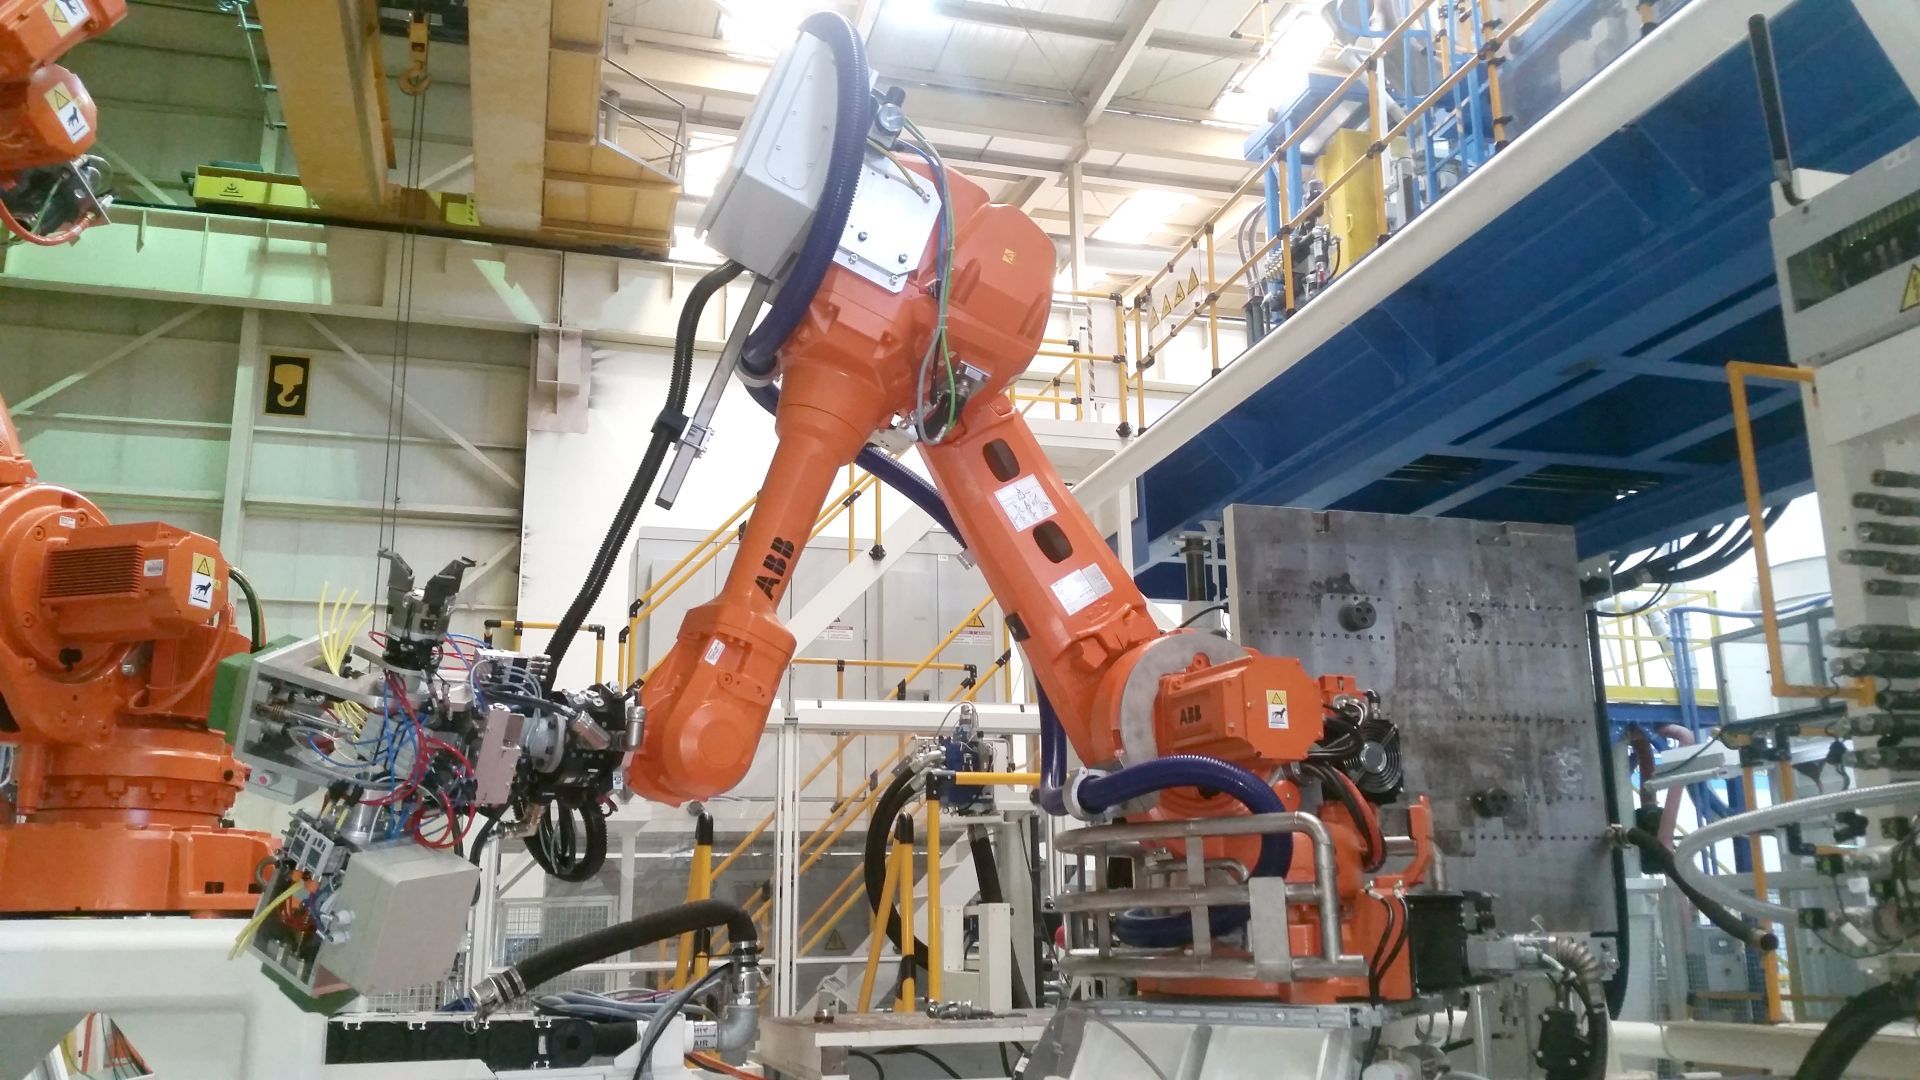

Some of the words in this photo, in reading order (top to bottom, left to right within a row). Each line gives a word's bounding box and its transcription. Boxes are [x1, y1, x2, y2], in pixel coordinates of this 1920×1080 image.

[755, 537, 794, 601] ABB
[1179, 704, 1202, 726] ABB
[694, 1039, 709, 1047] AIR
